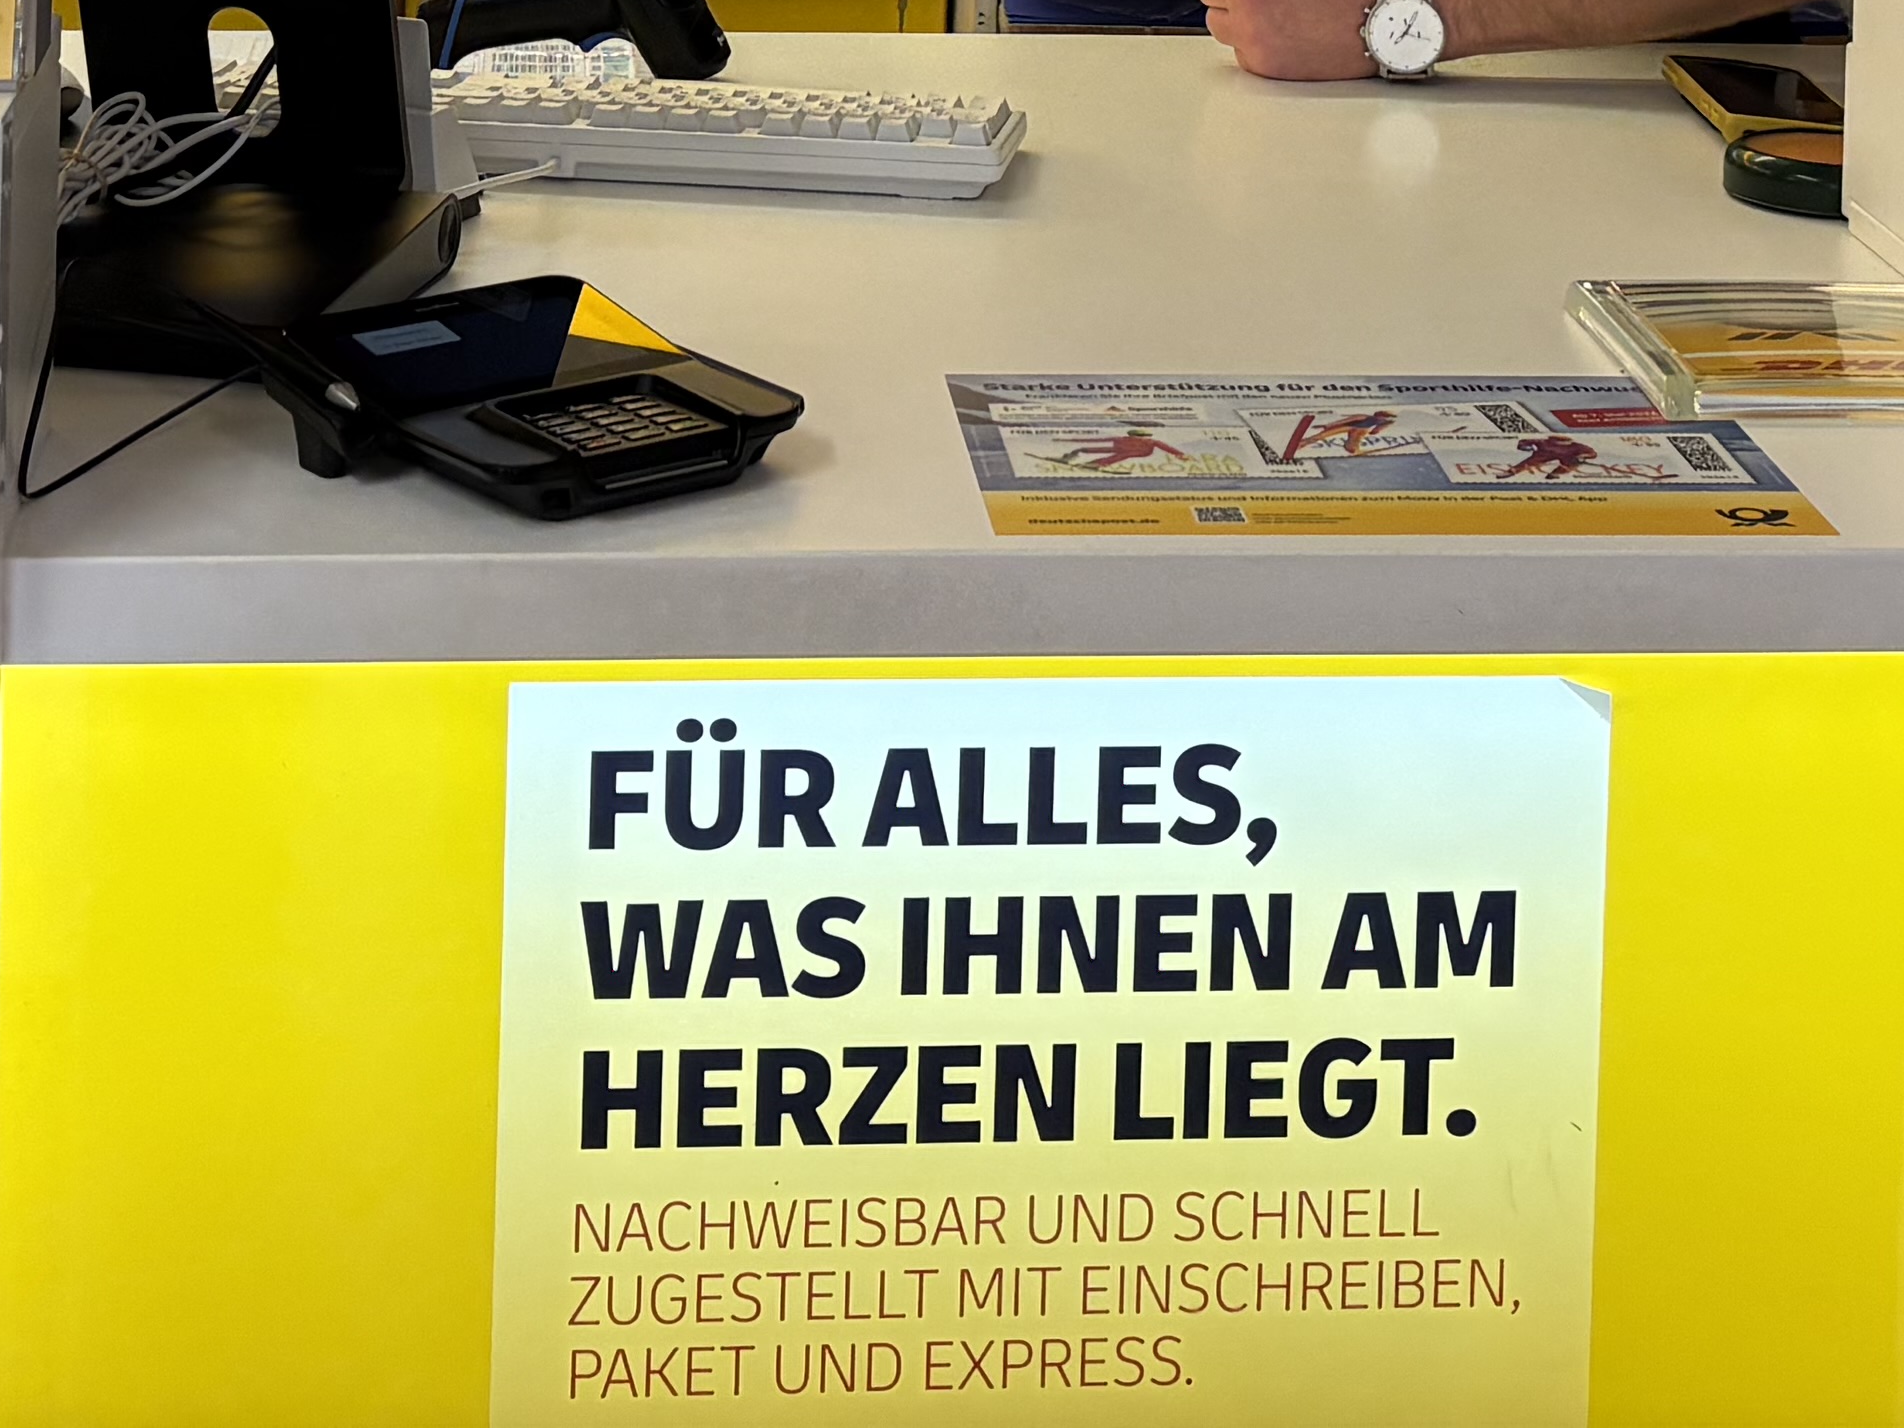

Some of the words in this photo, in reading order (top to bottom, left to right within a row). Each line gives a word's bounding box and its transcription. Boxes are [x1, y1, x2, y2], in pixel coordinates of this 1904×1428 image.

[983, 382, 1070, 392] Starke
[1077, 381, 1270, 394] Unterstützung
[1277, 382, 1315, 393] für
[1322, 383, 1371, 393] den
[588, 717, 836, 852] FÜR
[862, 743, 1279, 867] ALLES,
[581, 895, 867, 1000] WAS
[901, 892, 1293, 997] IHNEN
[1322, 889, 1517, 991] AM
[581, 1042, 1078, 1151] HERZEN
[1112, 1036, 1478, 1143] LIEGT.
[572, 1195, 1008, 1255] NACHWEISBAR
[1027, 1192, 1154, 1246] UND
[1174, 1188, 1440, 1242] SCHNELL
[569, 1267, 940, 1327] ZUGESTELLT
[957, 1266, 1062, 1319] MIT
[1081, 1257, 1521, 1316] EINSCHREIBEN,
[569, 1344, 755, 1400] PAKET
[774, 1341, 904, 1395] UND
[924, 1335, 1195, 1393] EXPRESS.
